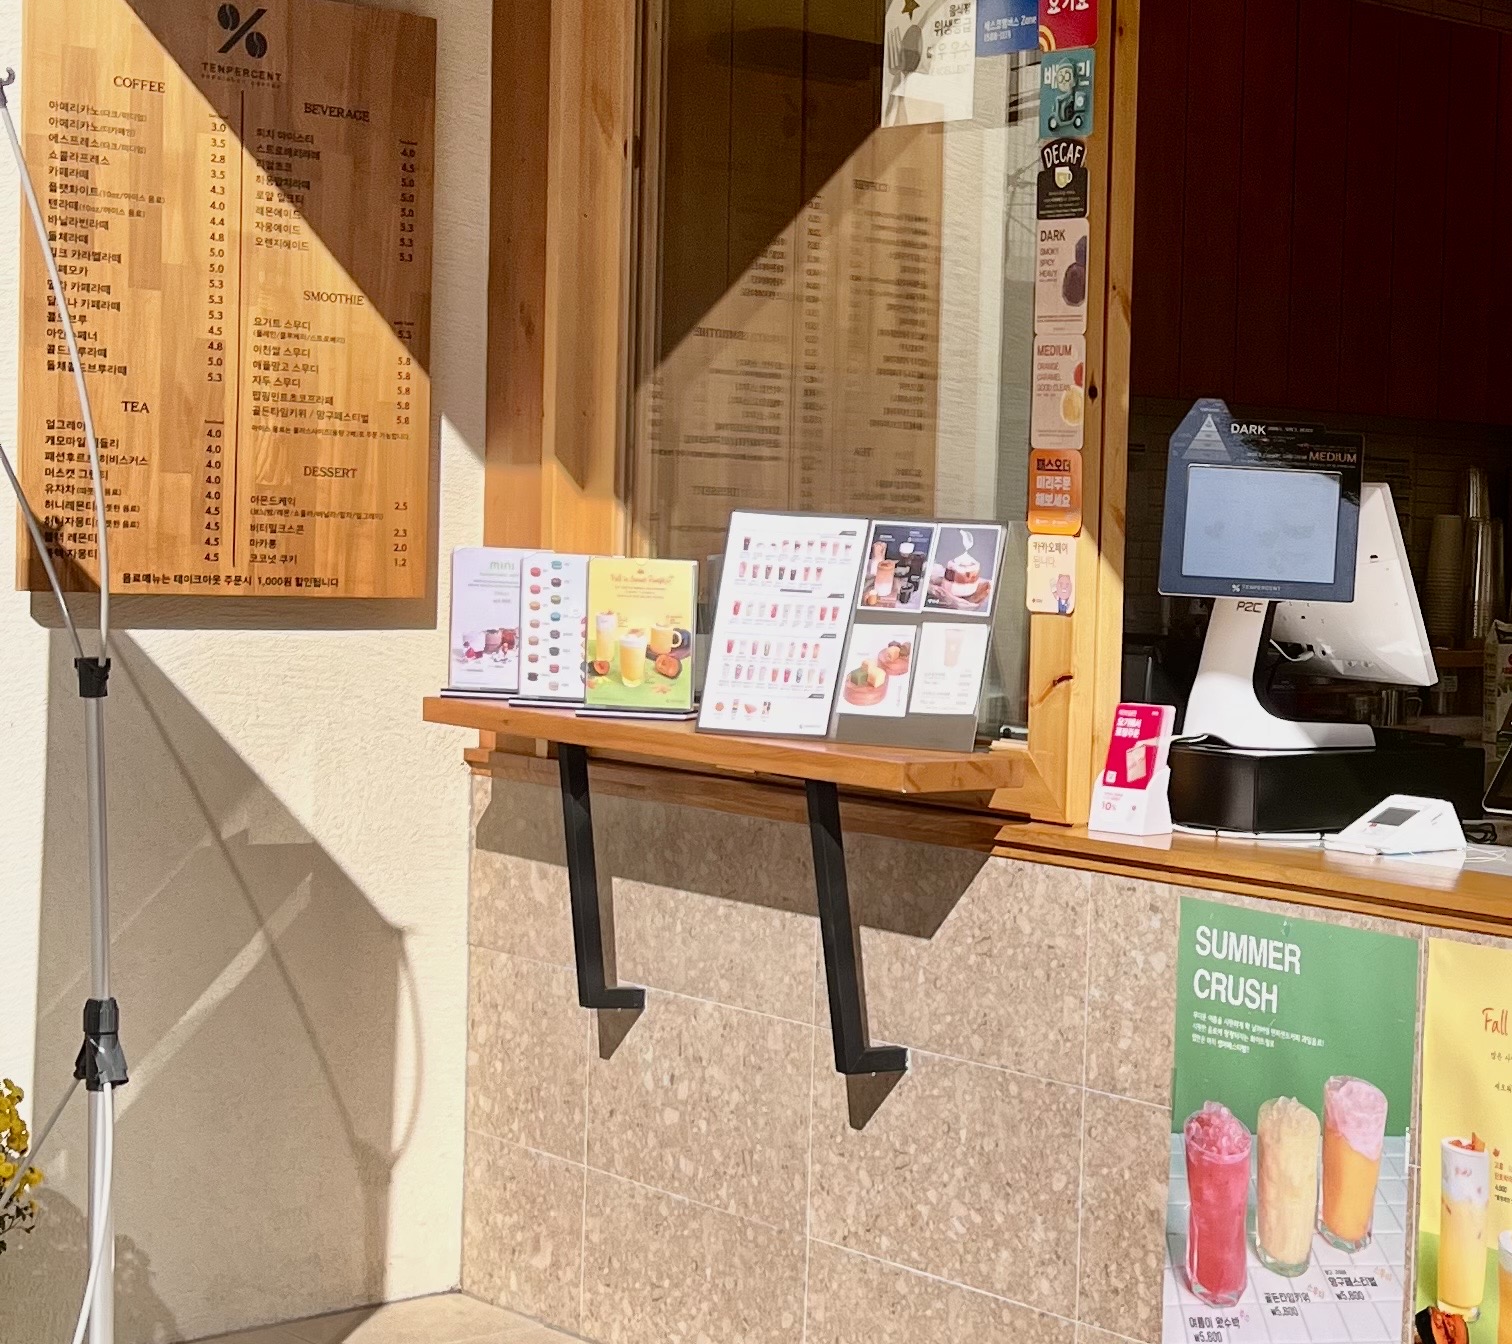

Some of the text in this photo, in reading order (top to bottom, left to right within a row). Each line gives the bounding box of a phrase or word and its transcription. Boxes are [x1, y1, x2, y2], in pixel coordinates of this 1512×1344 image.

[934, 17, 971, 37] 위생등급
[201, 62, 282, 81] TENPERCENT
[113, 76, 166, 93] COFFEE
[304, 102, 370, 123] BEVERAGE
[211, 123, 227, 133] 3.0
[210, 138, 226, 148] 3.5
[210, 154, 226, 164] 2.8
[1043, 142, 1084, 169] DECAF
[210, 170, 226, 180] 3.5
[209, 185, 226, 195] 4.3
[209, 201, 226, 211] 4.0
[209, 216, 226, 226] 4.4
[209, 232, 225, 242] 4.8
[1039, 229, 1066, 243] DARK
[209, 248, 225, 258] 5.0
[208, 264, 225, 273] 5.0
[208, 279, 224, 289] 5.3
[208, 295, 224, 304] 5.3
[303, 290, 365, 306] SMOOTHIE
[208, 310, 223, 320] 5.3
[253, 316, 311, 331] 요거트 스무디
[207, 326, 223, 335] 4.5
[207, 341, 223, 351] 4.8
[1037, 344, 1072, 356] MEDIUM
[284, 346, 311, 358] 스무디
[207, 357, 223, 366] 5.0
[397, 356, 411, 366] 5.8
[292, 362, 319, 374] 스무디
[207, 372, 223, 382] 5.3
[397, 371, 411, 381] 5.8
[252, 375, 301, 388] 자두 스무디
[397, 386, 411, 396] 5.8
[121, 400, 150, 414] TEA
[396, 401, 410, 411] 5.8
[396, 416, 410, 425] 5.8
[206, 429, 222, 439] 4.0
[1230, 423, 1266, 435] DARK
[206, 445, 222, 454] 4.0
[1308, 451, 1357, 463] MEDIUM
[205, 460, 221, 470] 4.0
[303, 465, 358, 479] DESSERT
[205, 476, 221, 485] 4.0
[44, 483, 76, 496] 유자차
[205, 491, 221, 500] 4.0
[204, 507, 220, 516] 4.5
[394, 502, 408, 511] 2.5
[204, 522, 220, 531] 4.5
[67, 532, 98, 544] 레몬티
[394, 529, 408, 538] 2.3
[204, 537, 220, 546] 4.5
[394, 543, 408, 552] 2.0
[204, 553, 220, 562] 4.5
[394, 558, 407, 567] 1.2
[1237, 601, 1264, 613] P2C
[1195, 925, 1301, 975] SUMMER
[1193, 968, 1278, 1014] CRUSH
[1482, 1007, 1509, 1036] Fall
